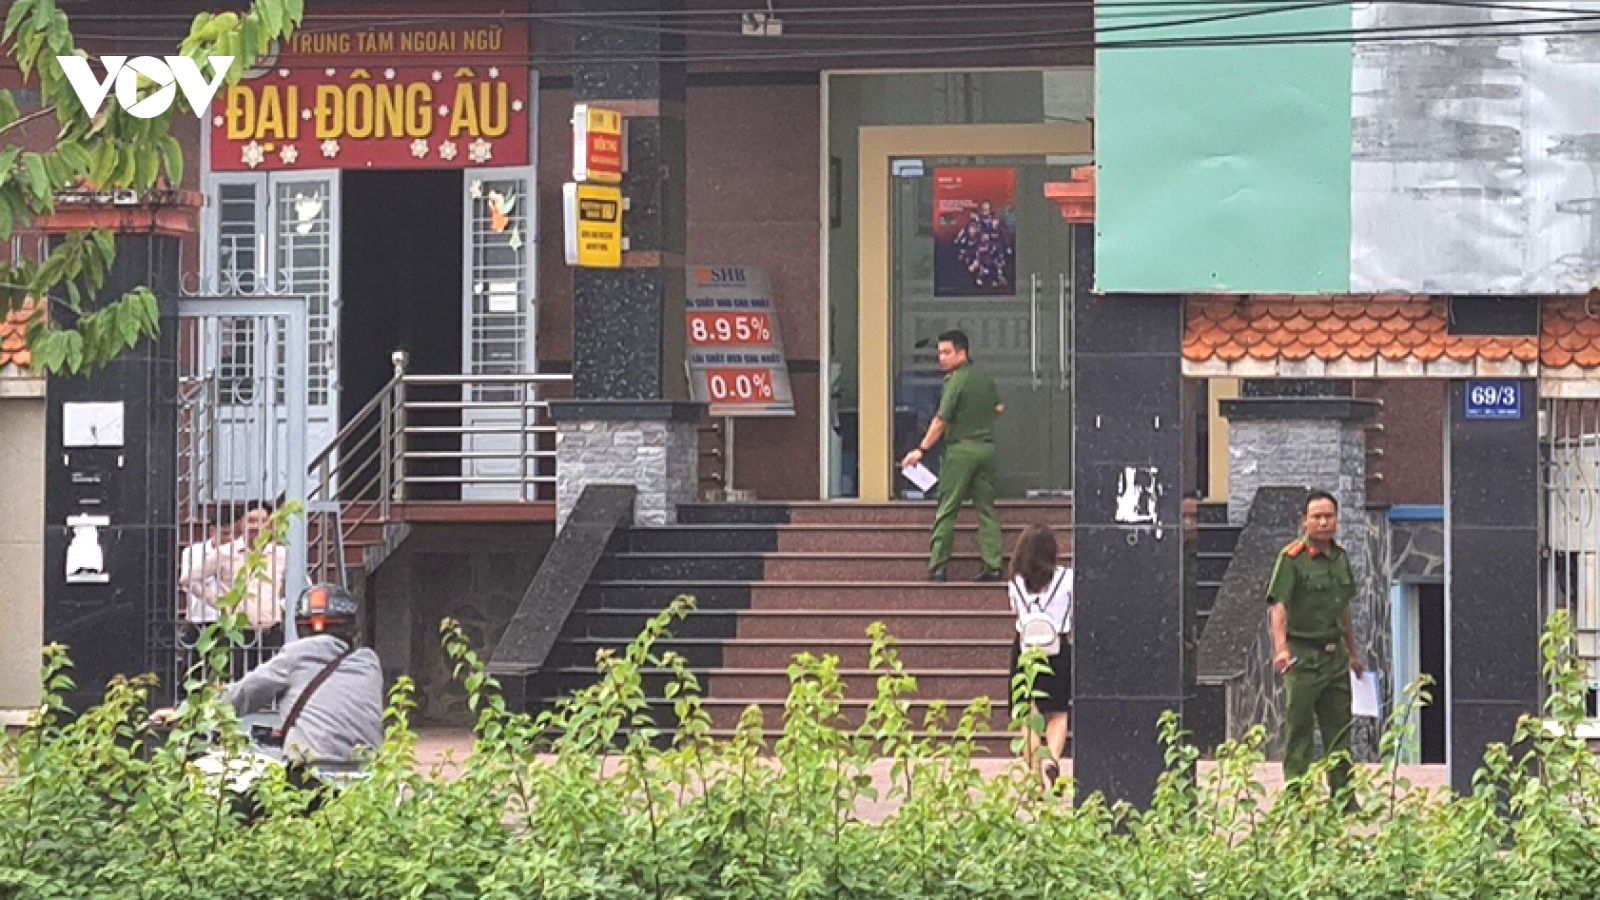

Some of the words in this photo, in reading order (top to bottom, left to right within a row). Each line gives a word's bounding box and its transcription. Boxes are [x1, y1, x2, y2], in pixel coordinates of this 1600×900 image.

[292, 33, 350, 53] TRUNG
[356, 27, 395, 52] TÂM
[464, 25, 503, 50] NGỮ
[226, 84, 298, 152] ĐẠI
[314, 68, 433, 140] ĐÔNG
[450, 66, 508, 137] ÂU
[711, 268, 746, 282] SHB
[711, 373, 772, 399] 0.0%
[1472, 386, 1515, 406] 69/3
